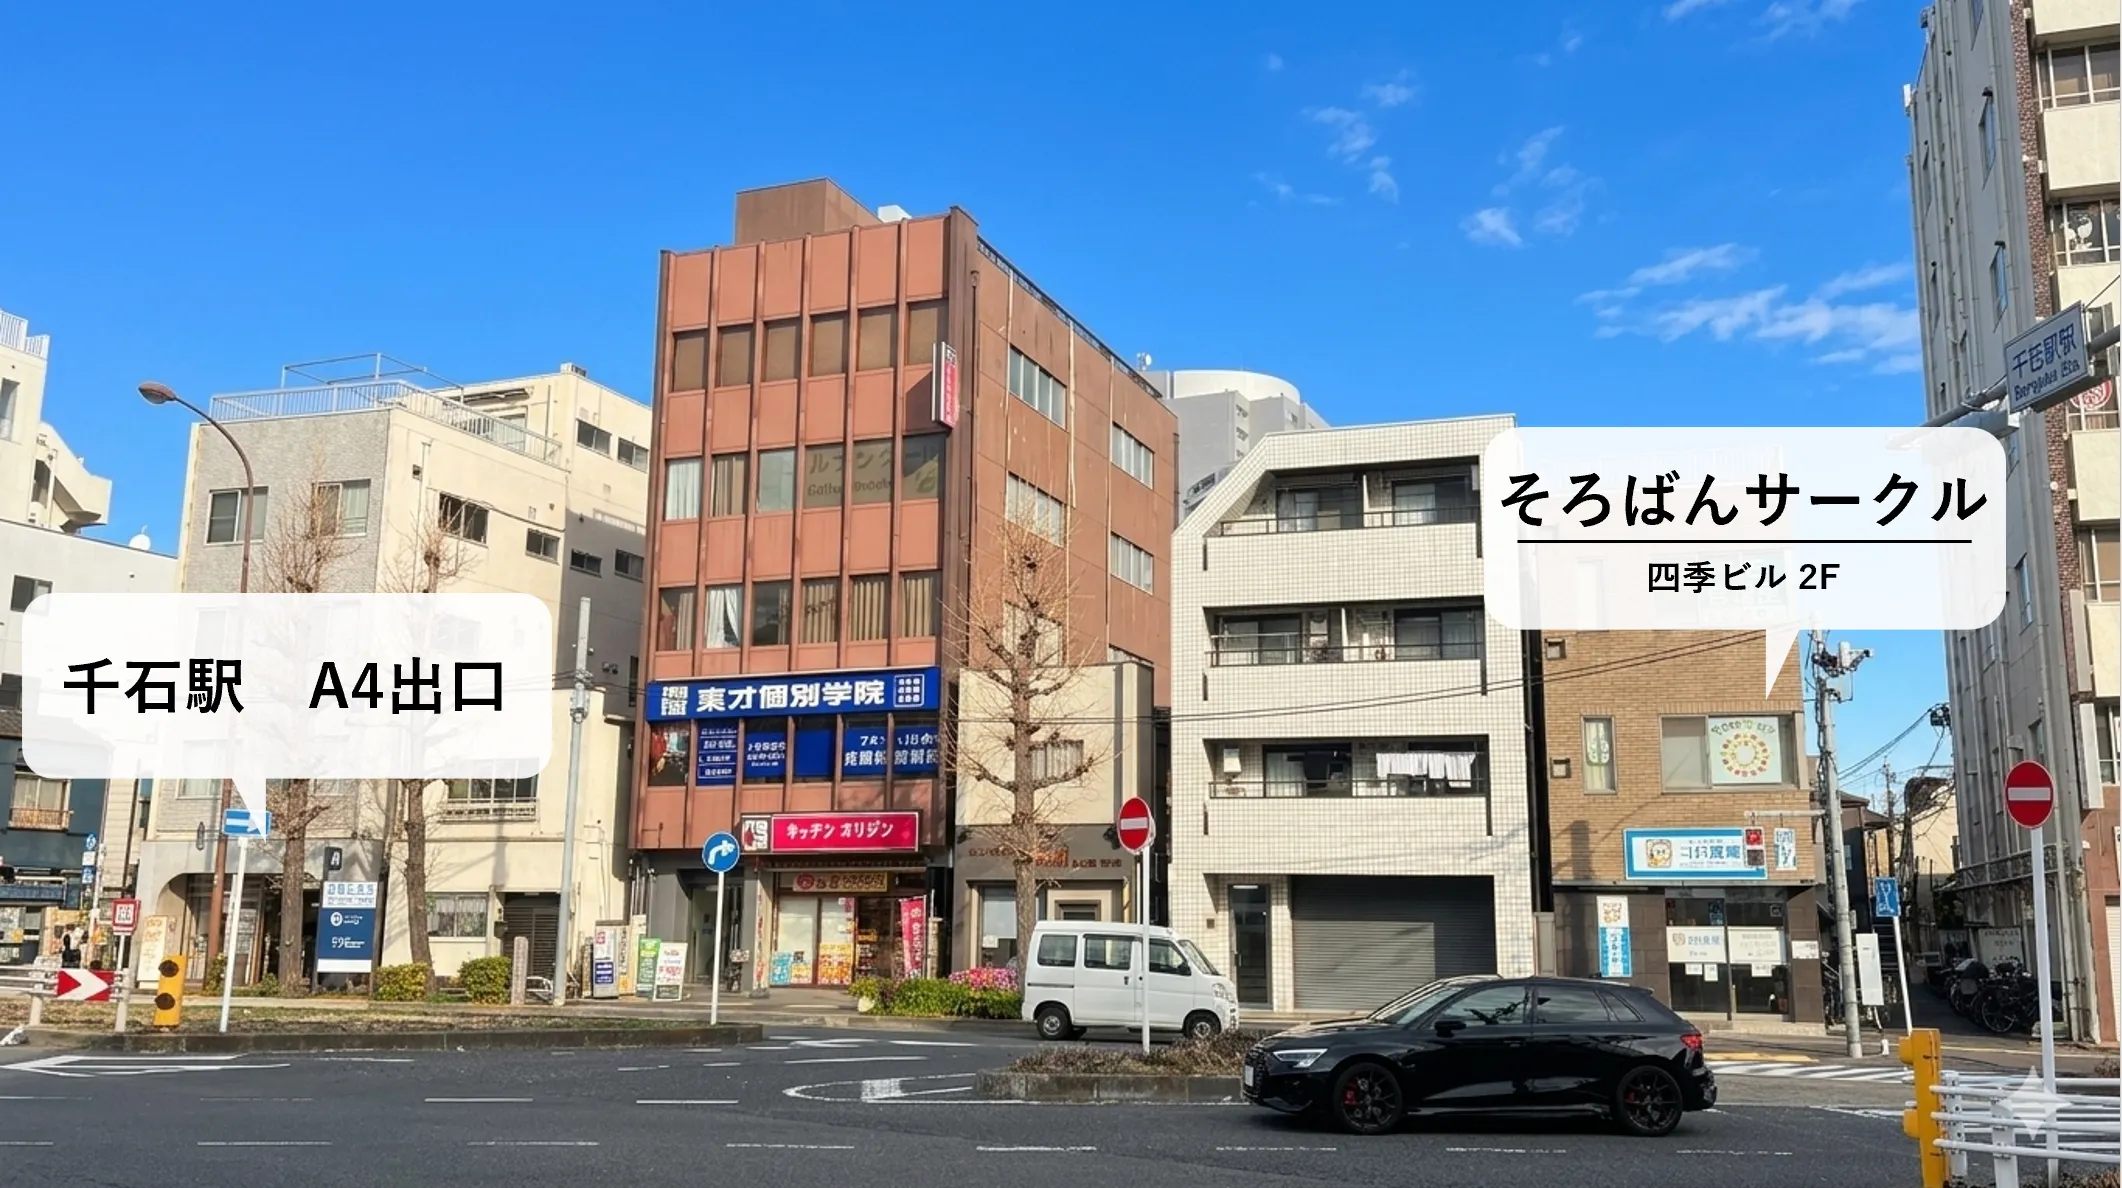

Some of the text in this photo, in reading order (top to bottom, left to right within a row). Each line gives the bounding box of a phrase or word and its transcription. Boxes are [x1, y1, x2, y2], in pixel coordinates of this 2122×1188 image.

[786, 822, 836, 840] キッチン
[840, 819, 894, 839] オリジン
[330, 851, 341, 866] A
